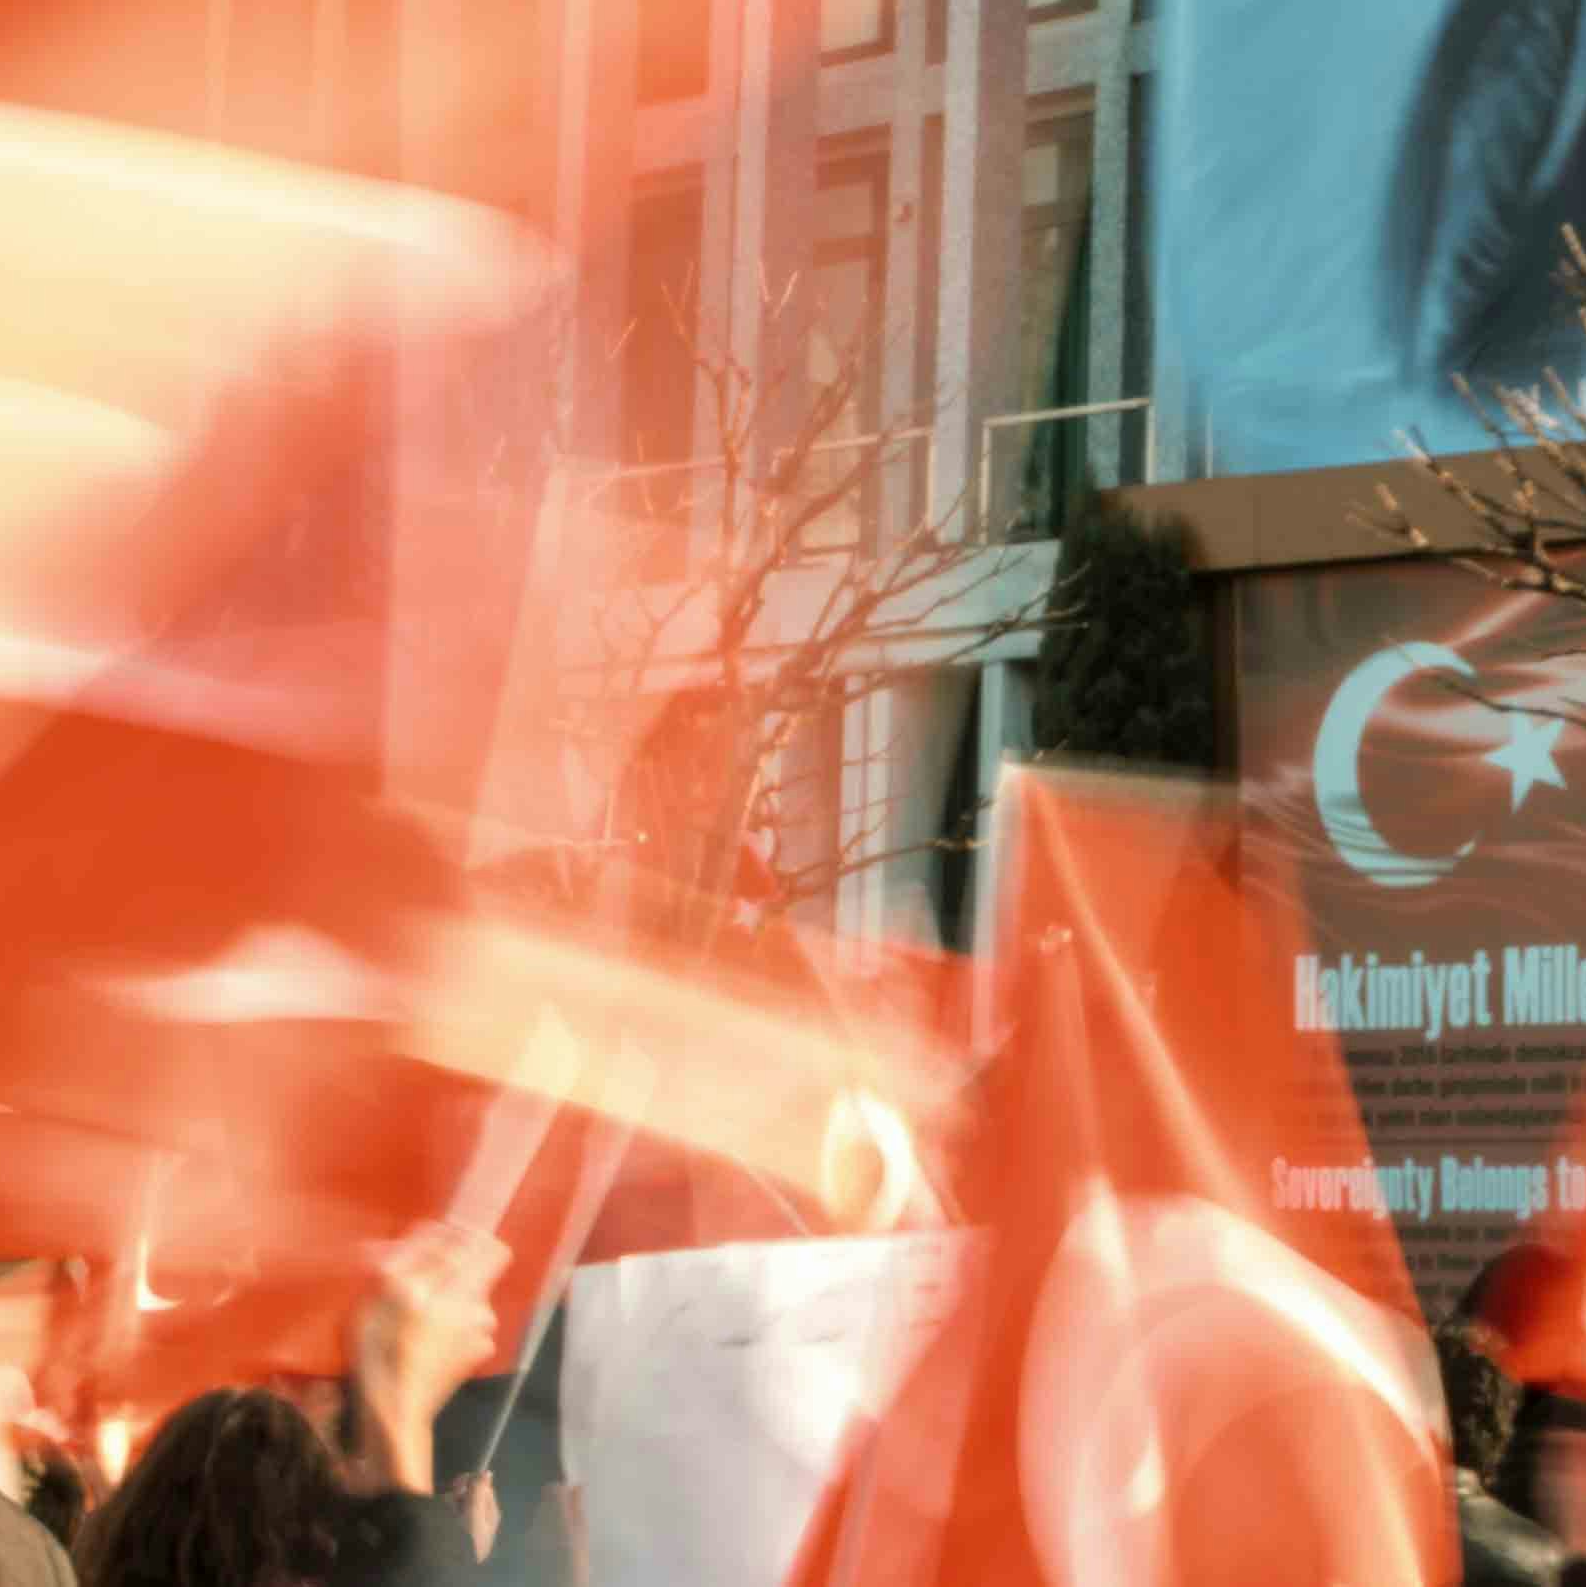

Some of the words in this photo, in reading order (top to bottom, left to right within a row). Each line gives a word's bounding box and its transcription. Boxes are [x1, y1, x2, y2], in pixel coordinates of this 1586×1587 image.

[1294, 949, 1491, 1040] Hakimiyet
[1271, 1155, 1435, 1221] Sovereignty
[1439, 1154, 1549, 1221] Belongs
